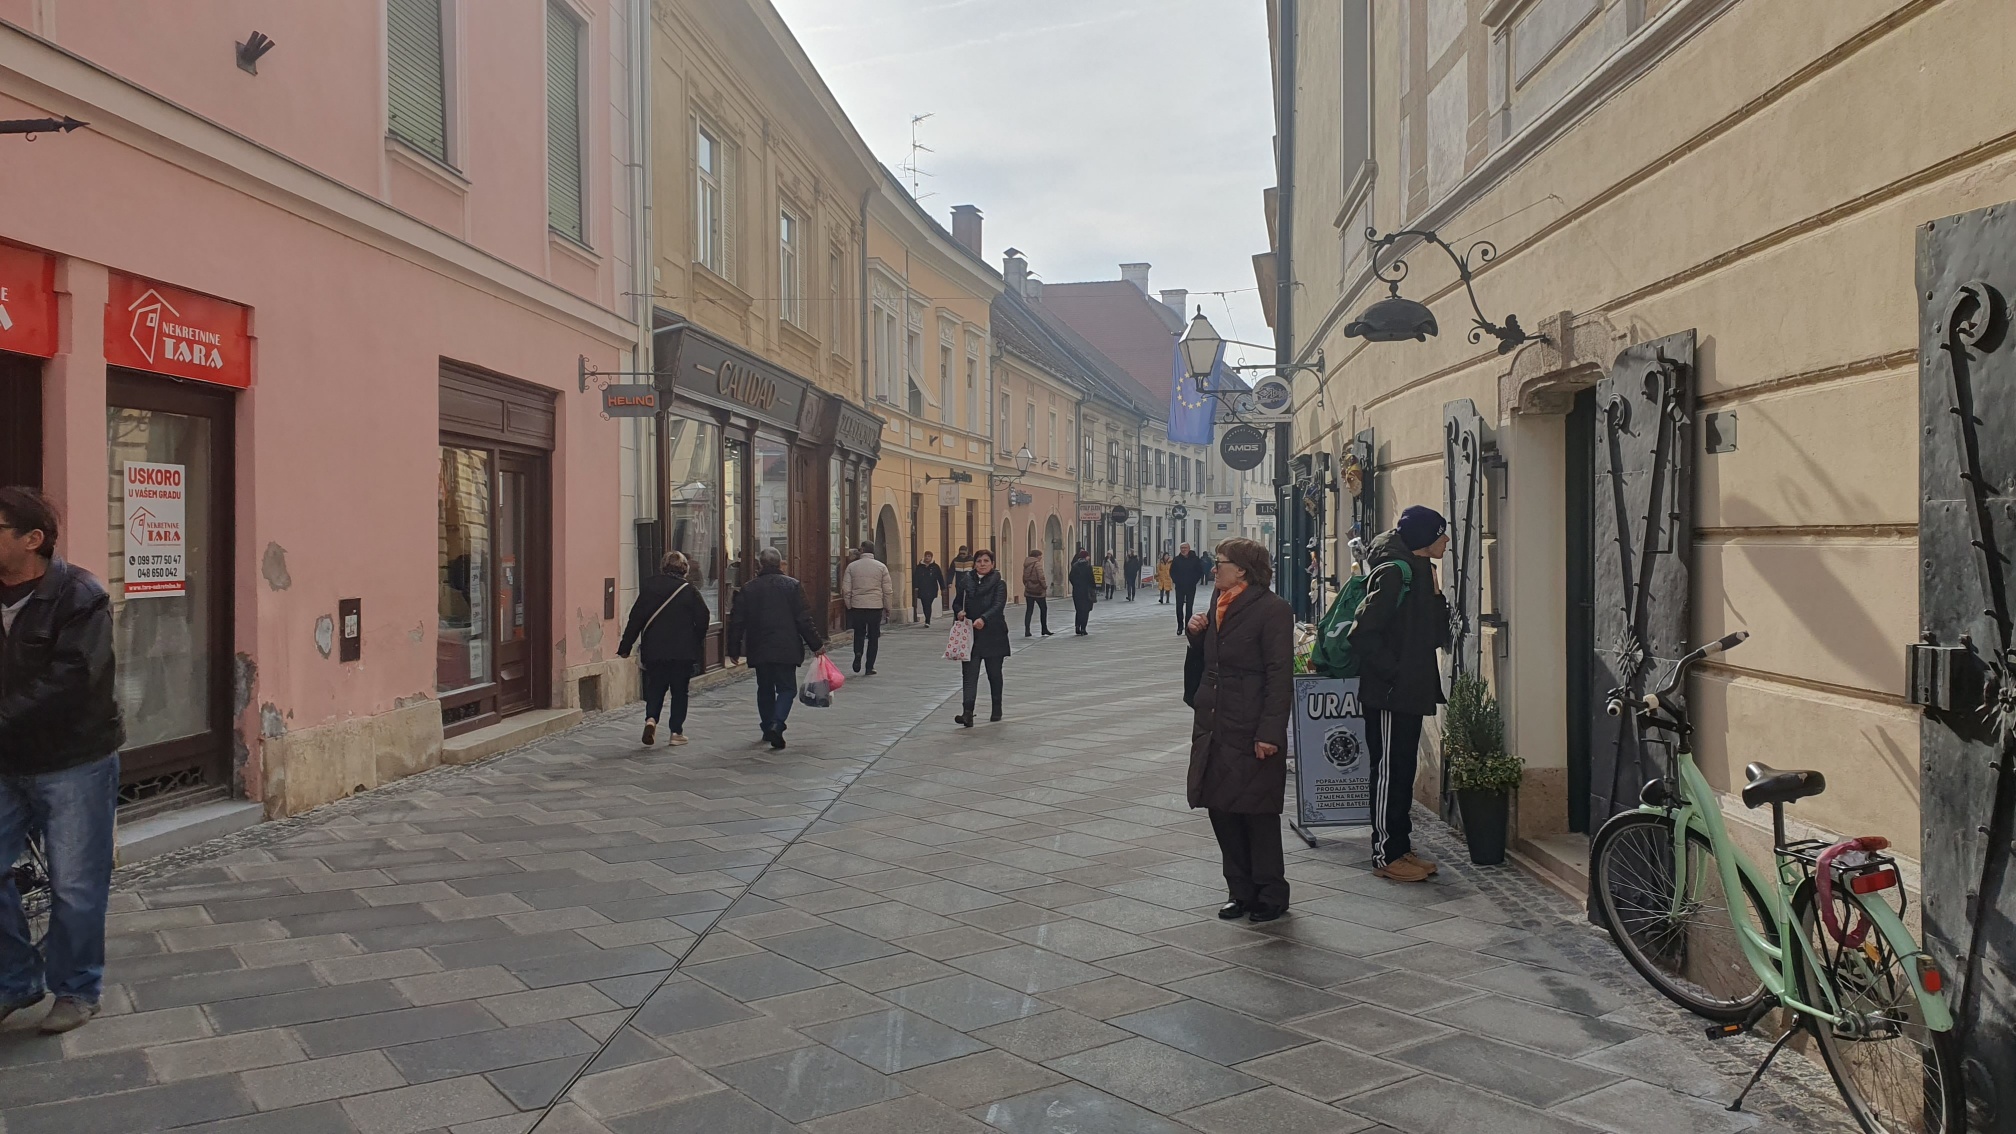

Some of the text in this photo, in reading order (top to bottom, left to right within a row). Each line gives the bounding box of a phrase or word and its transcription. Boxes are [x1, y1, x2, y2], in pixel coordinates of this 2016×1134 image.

[162, 321, 221, 345] NEKRETNINE
[162, 337, 223, 369] TARA
[718, 359, 778, 411] CALIDAD
[607, 394, 655, 408] HELINO
[1228, 444, 1259, 452] AMOS
[128, 467, 181, 486] USKORO
[128, 487, 181, 500] U VAŠEM GRADU
[1261, 505, 1275, 514] LIS
[147, 530, 181, 542] TARA
[137, 554, 181, 565] 099 377 50 47
[137, 567, 178, 578] 048 650 042
